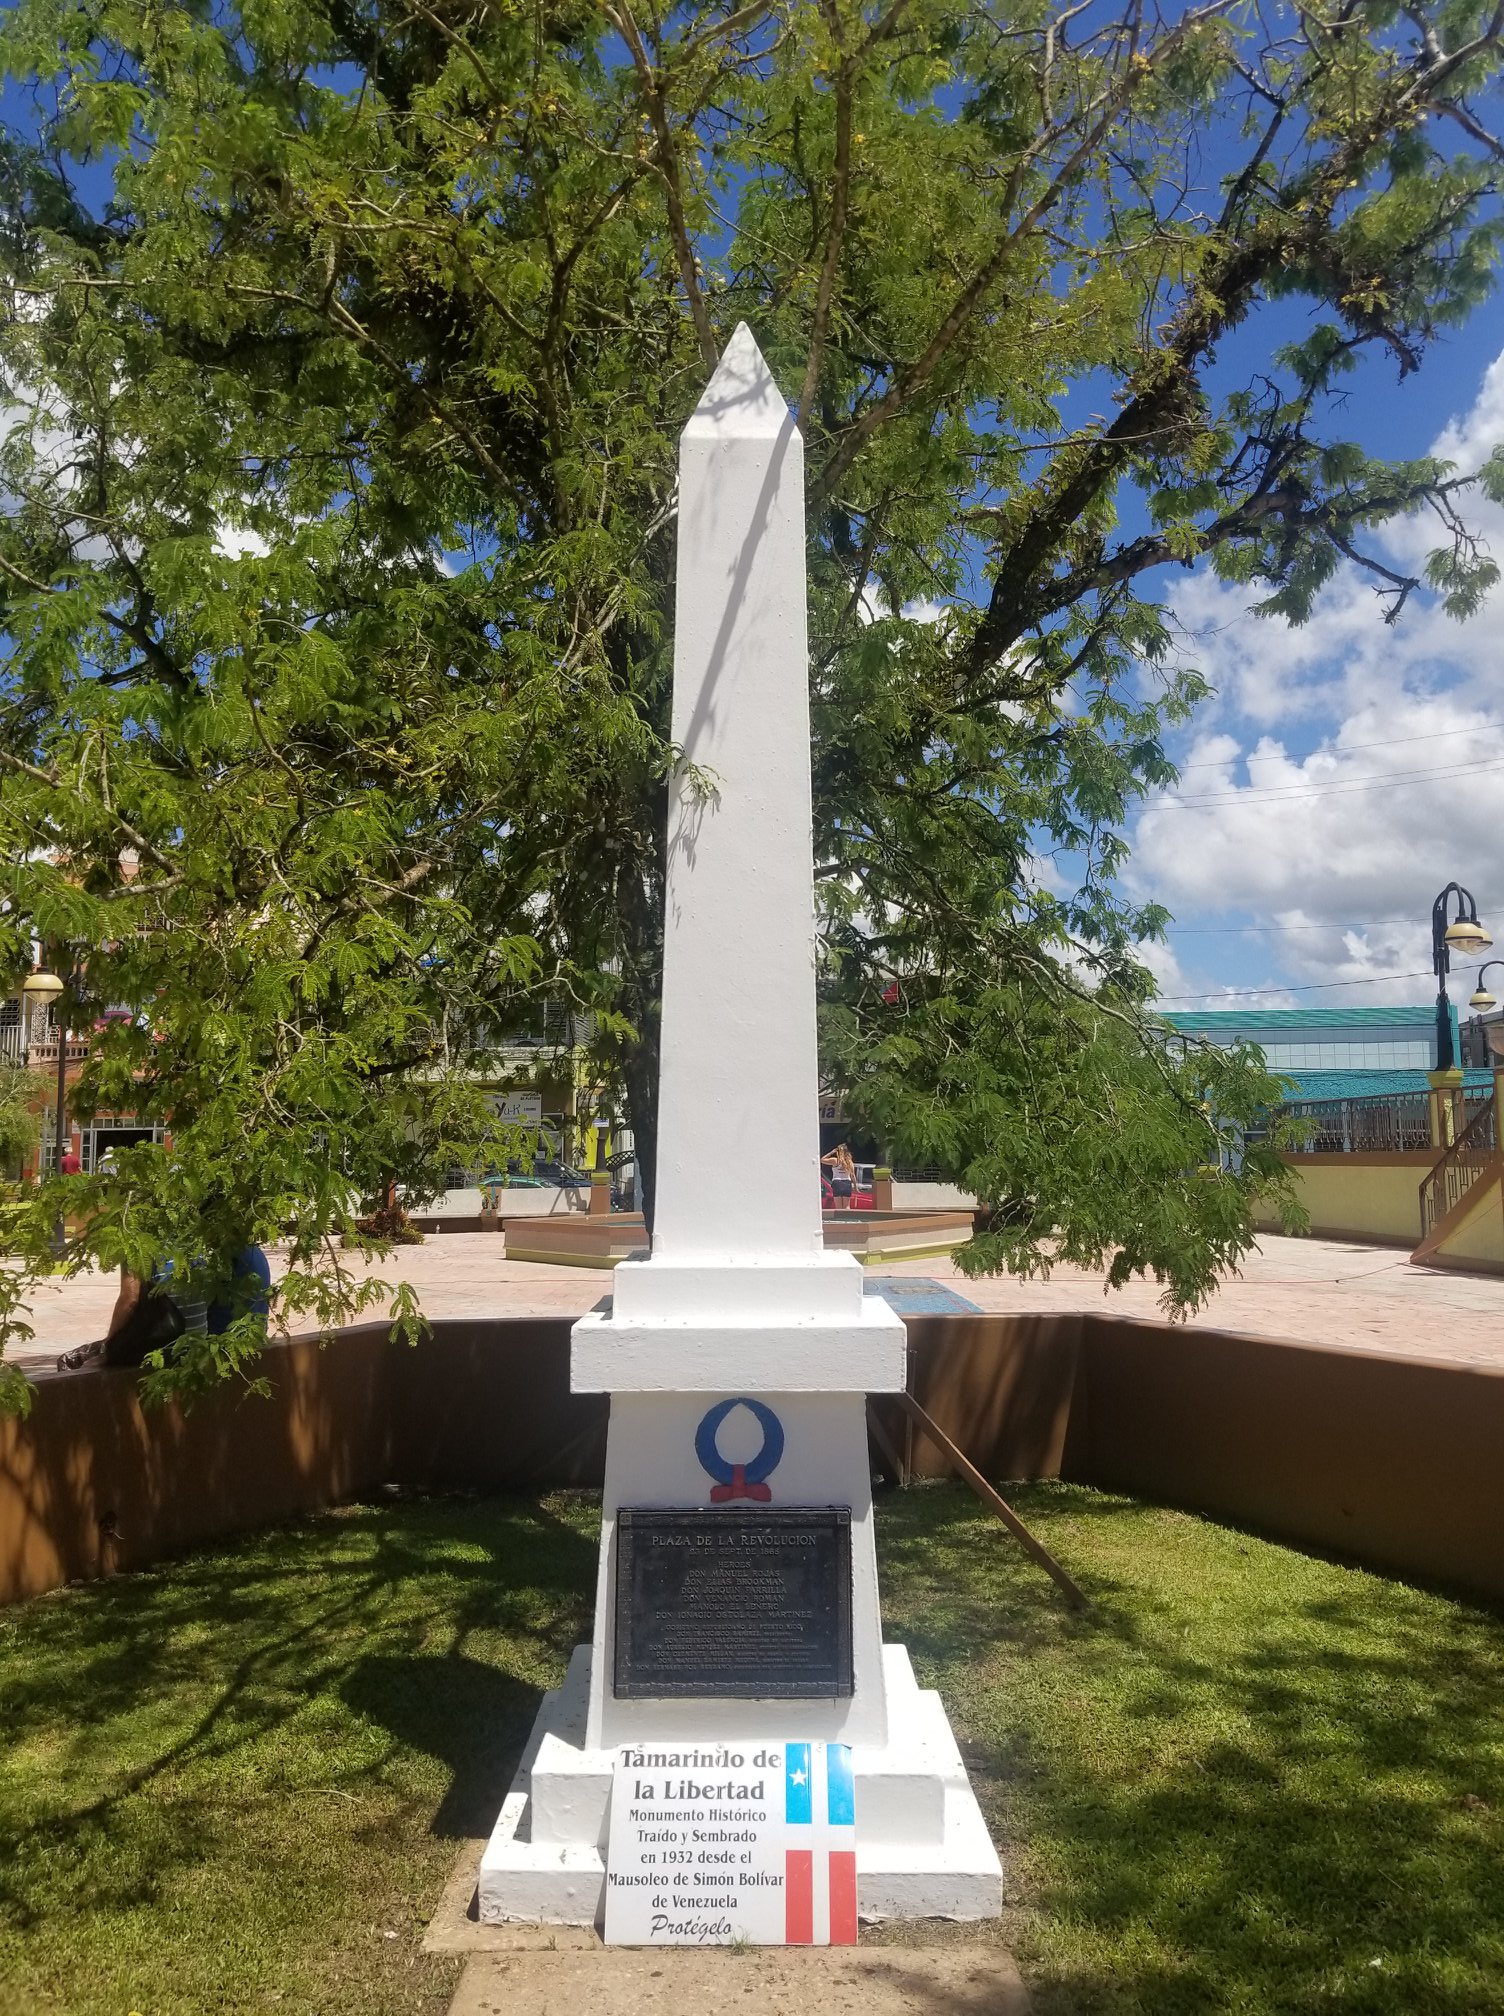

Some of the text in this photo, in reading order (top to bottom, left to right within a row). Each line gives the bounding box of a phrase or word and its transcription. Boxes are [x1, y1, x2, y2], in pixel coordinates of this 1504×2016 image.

[652, 1535, 816, 1546] PLAZA DE LA REVOLUCION
[685, 1578, 702, 1586] DON
[681, 1586, 699, 1594] DON
[656, 1611, 673, 1619] DON
[621, 1749, 781, 1768] Tamarindo de
[634, 1780, 765, 1800] la Libertad
[629, 1808, 767, 1822] Monumento Histórico
[637, 1829, 757, 1845] Traído y Sembrado
[640, 1851, 752, 1864] en 1932 desde el
[608, 1870, 784, 1886] Mausoleo de Simón Bolívar
[652, 1895, 738, 1908] de Venezuela
[651, 1914, 732, 1942] Protégelo
